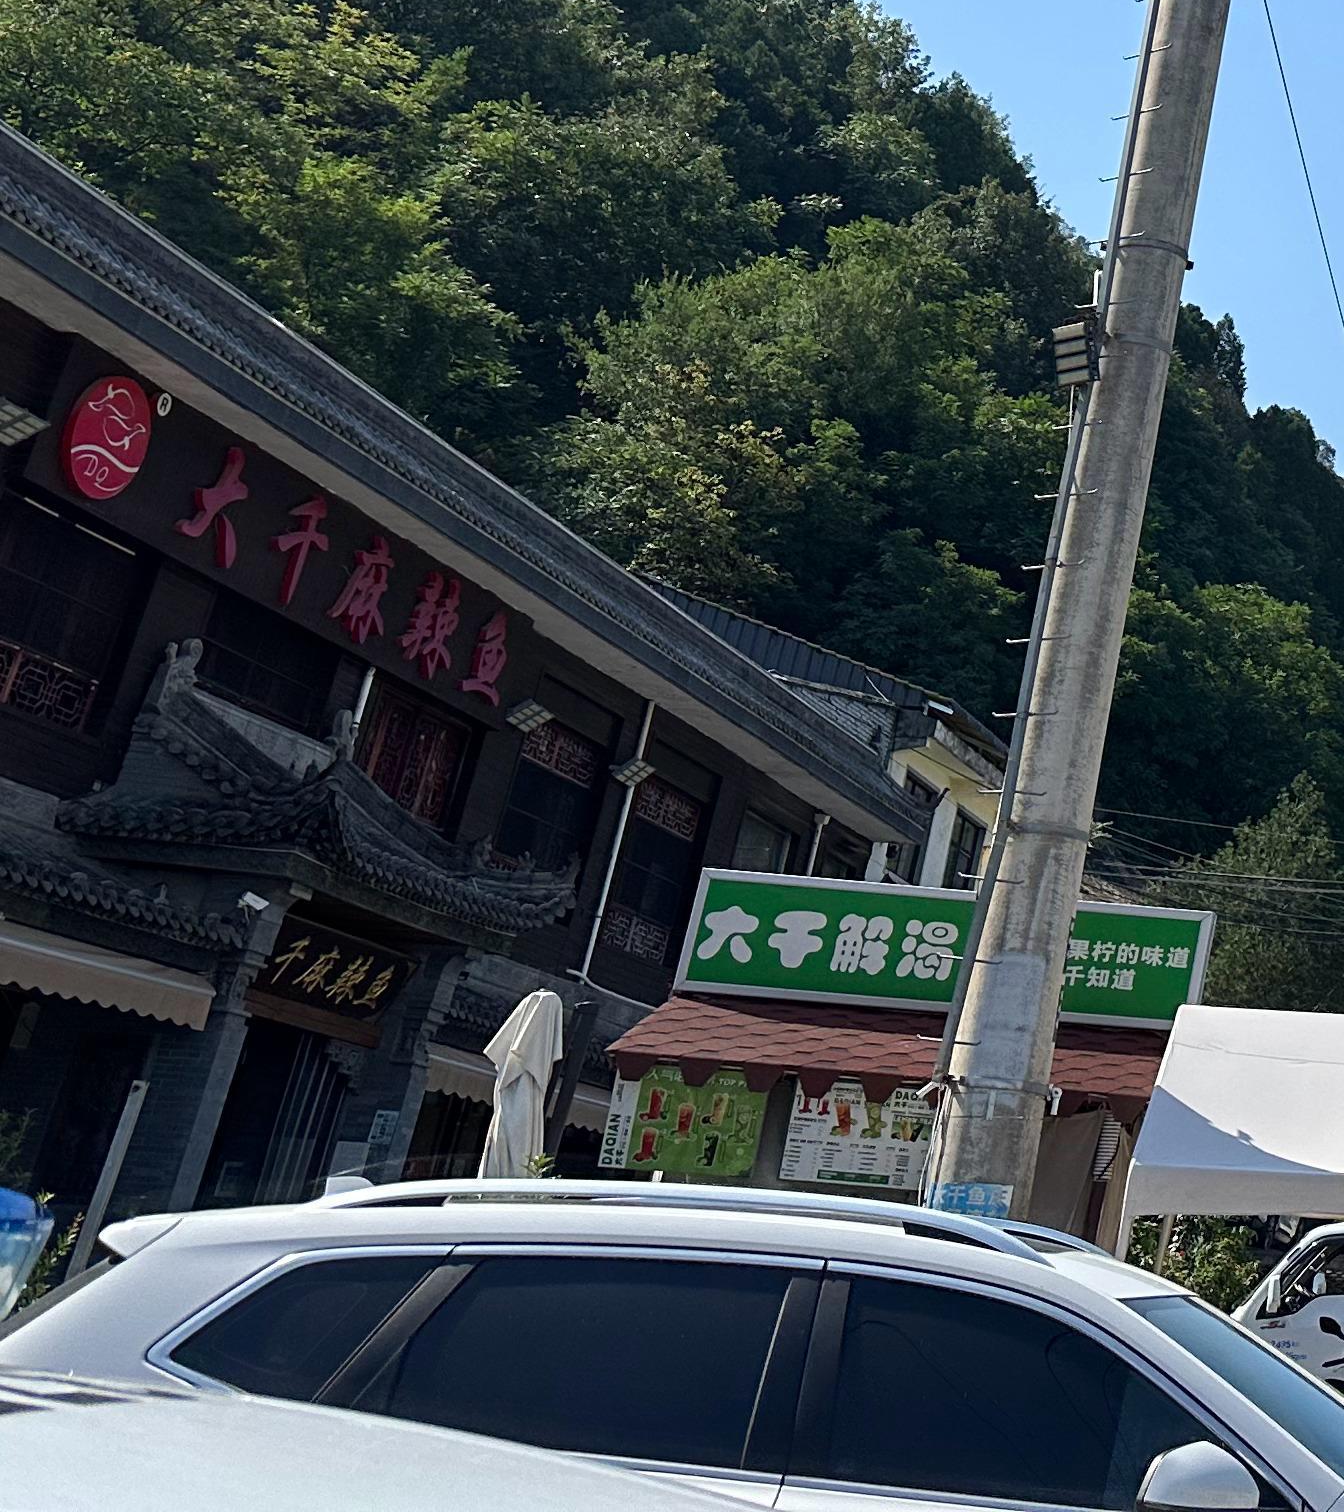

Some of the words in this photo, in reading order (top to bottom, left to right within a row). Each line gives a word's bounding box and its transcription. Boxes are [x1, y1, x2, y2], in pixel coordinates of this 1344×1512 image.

[175, 447, 508, 707] 大千麻辣鱼
[697, 905, 959, 981] 大千解渴
[1065, 965, 1137, 991] 千知道
[601, 1113, 621, 1165] DAQIAN
